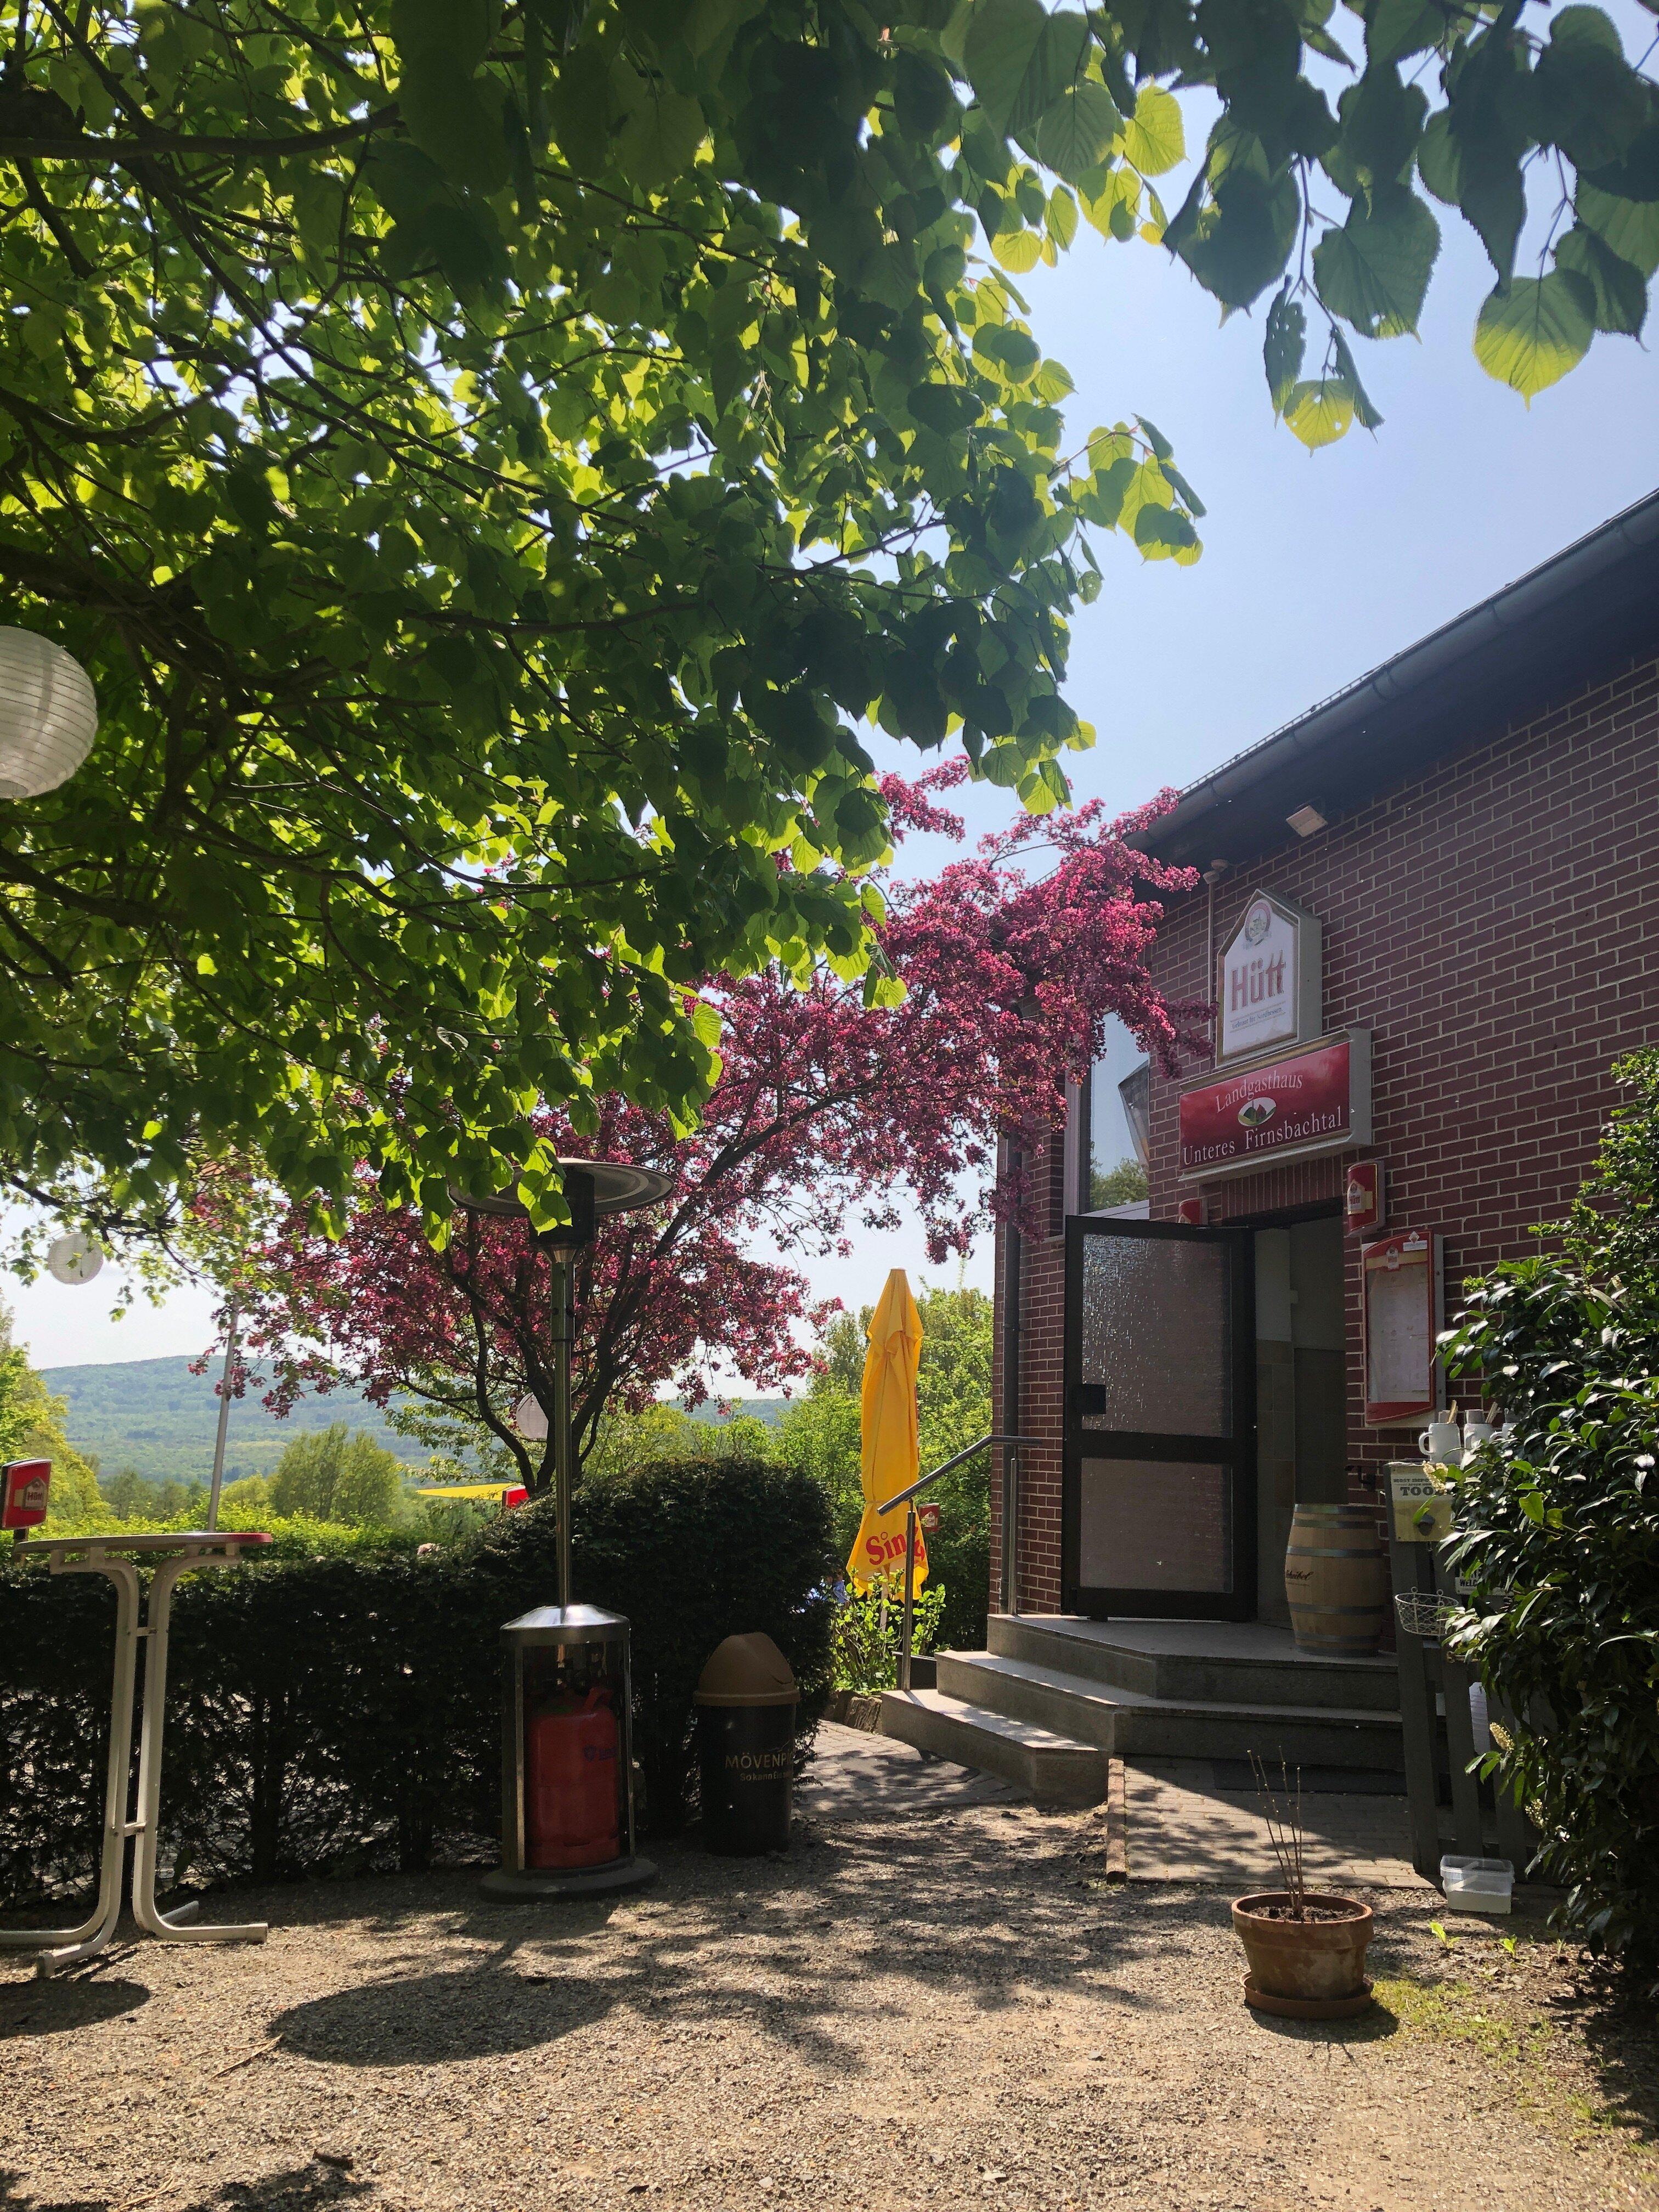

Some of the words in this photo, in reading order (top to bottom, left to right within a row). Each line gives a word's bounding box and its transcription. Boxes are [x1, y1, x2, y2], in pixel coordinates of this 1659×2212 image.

[1232, 950, 1286, 1011] Hütt
[1215, 1070, 1303, 1113] Landgasthaus
[1183, 1140, 1235, 1166] Unteres
[1245, 1105, 1342, 1150] Firnsbachtal
